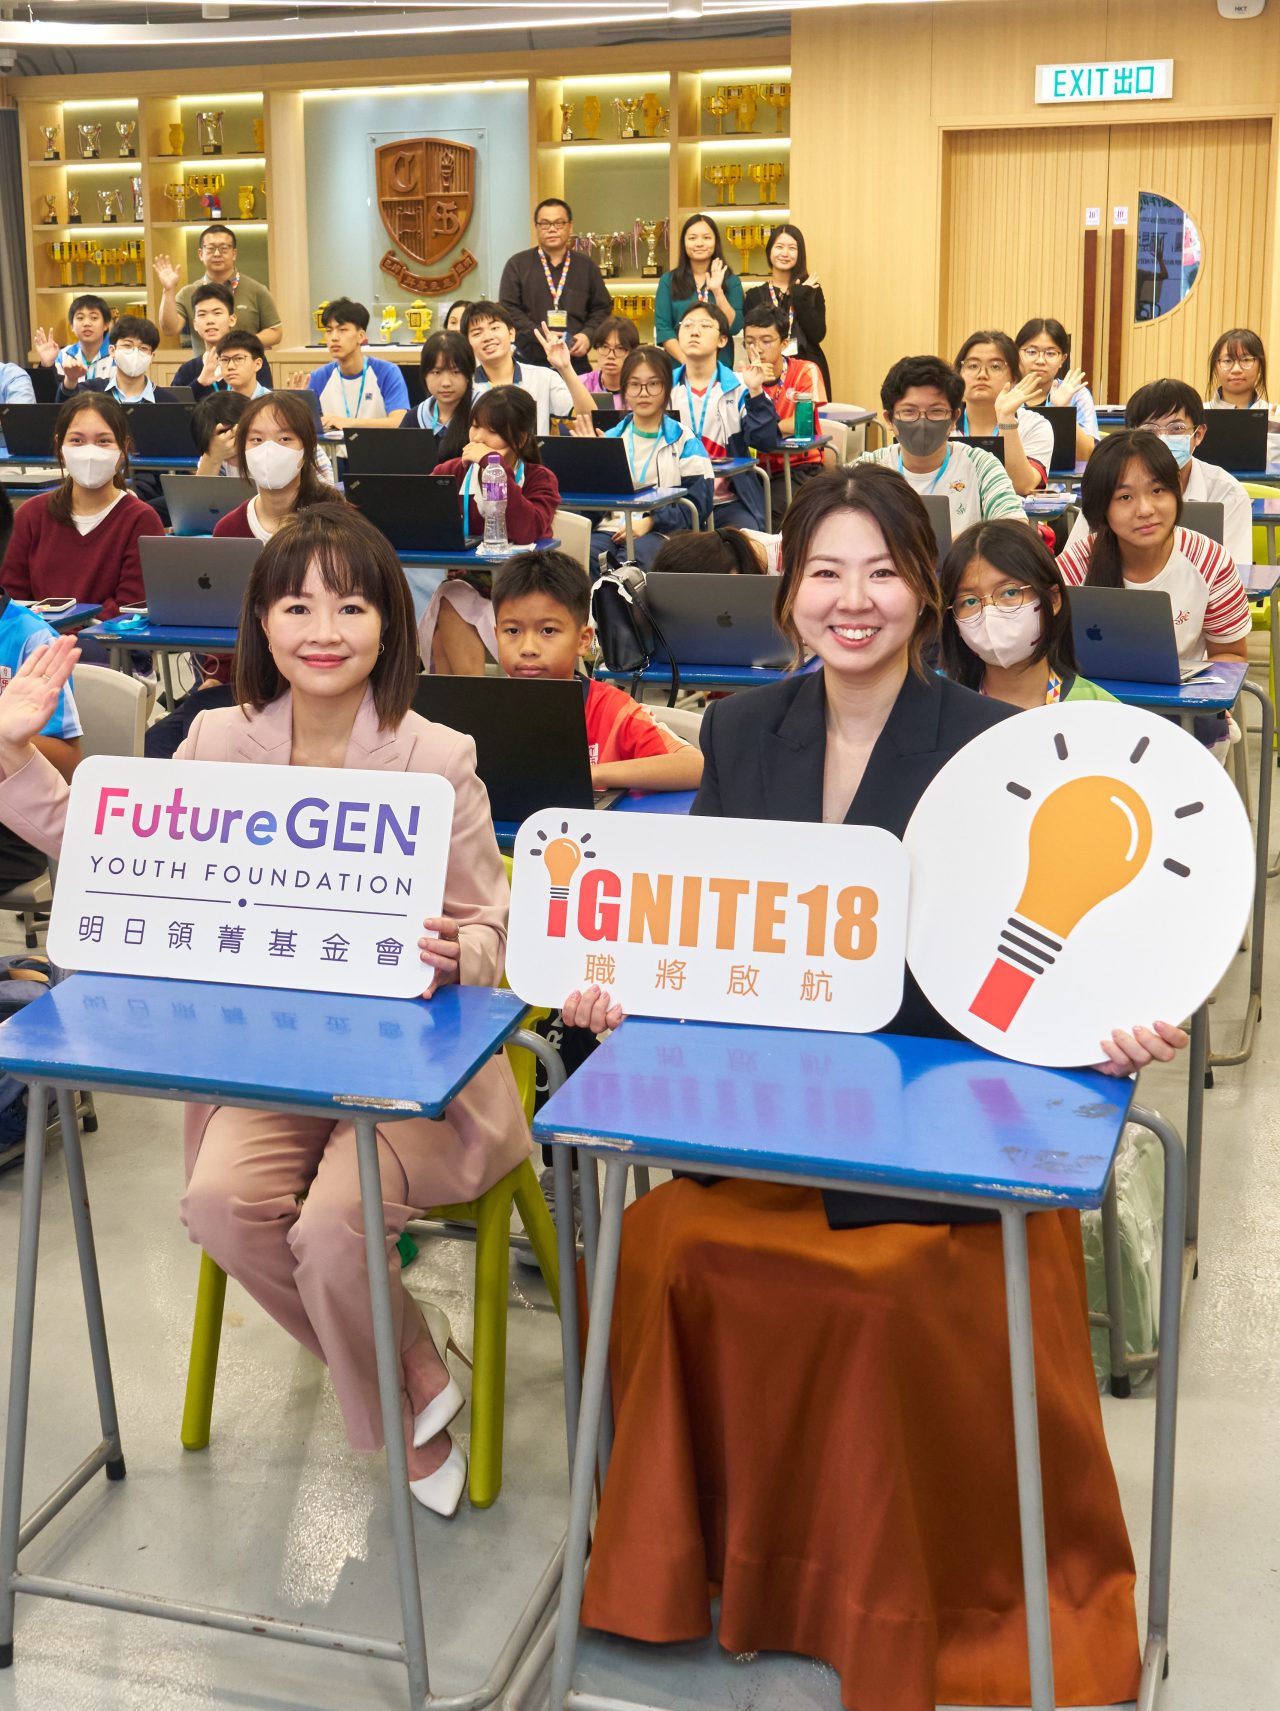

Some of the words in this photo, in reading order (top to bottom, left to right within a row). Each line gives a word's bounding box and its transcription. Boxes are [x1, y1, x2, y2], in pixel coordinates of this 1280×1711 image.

[1054, 68, 1109, 97] EXIT
[1114, 66, 1154, 94] 出口
[94, 786, 421, 856] FutureGEN
[90, 855, 187, 880] YOUTH
[205, 863, 413, 896] FOUNDATION
[78, 915, 405, 966] 明日領菁基金會
[584, 953, 834, 1002] 職將啟航
